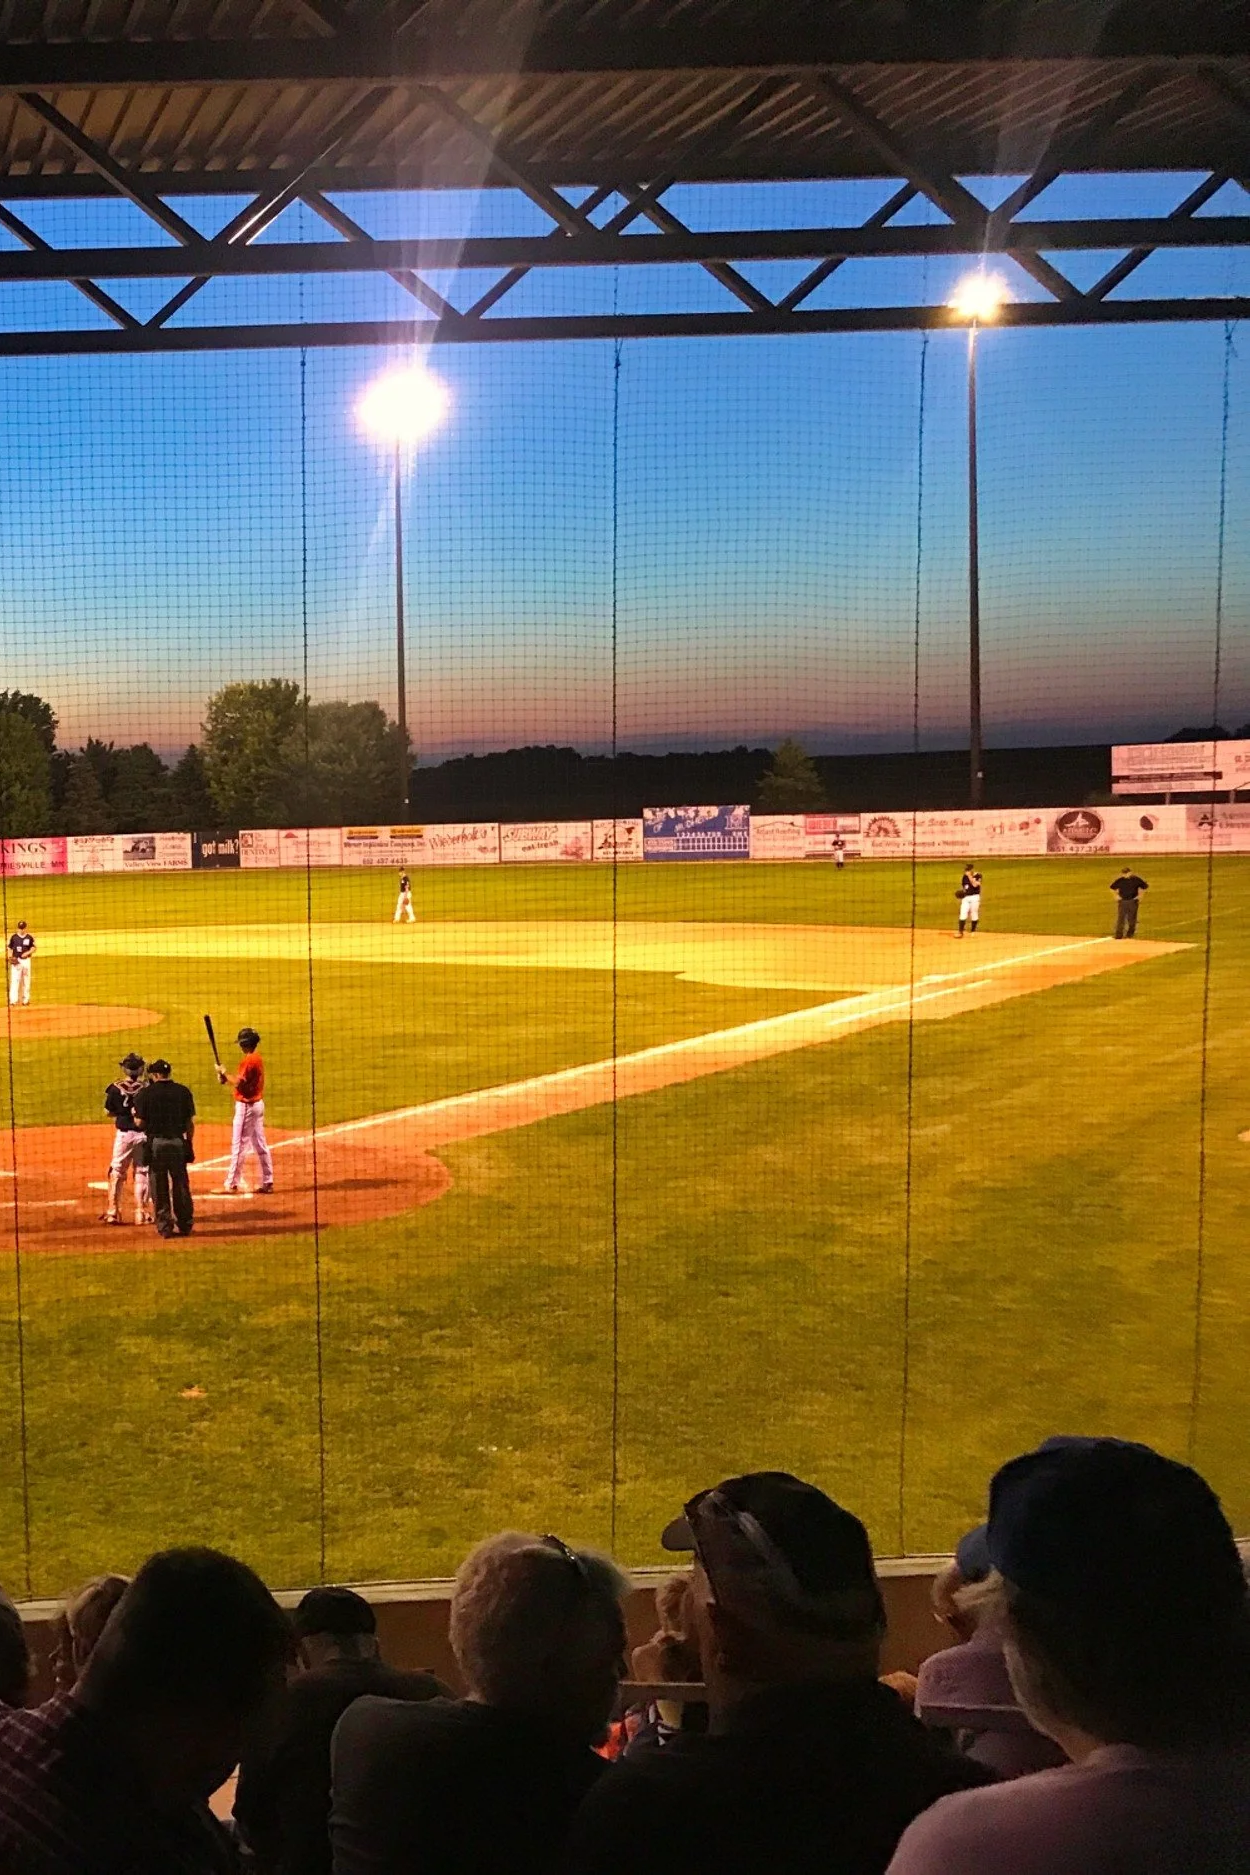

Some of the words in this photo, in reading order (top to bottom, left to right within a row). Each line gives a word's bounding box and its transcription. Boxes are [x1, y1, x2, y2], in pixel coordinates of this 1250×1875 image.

[1, 842, 47, 854] KINGS
[202, 841, 216, 858] got
[218, 839, 240, 855] milk?
